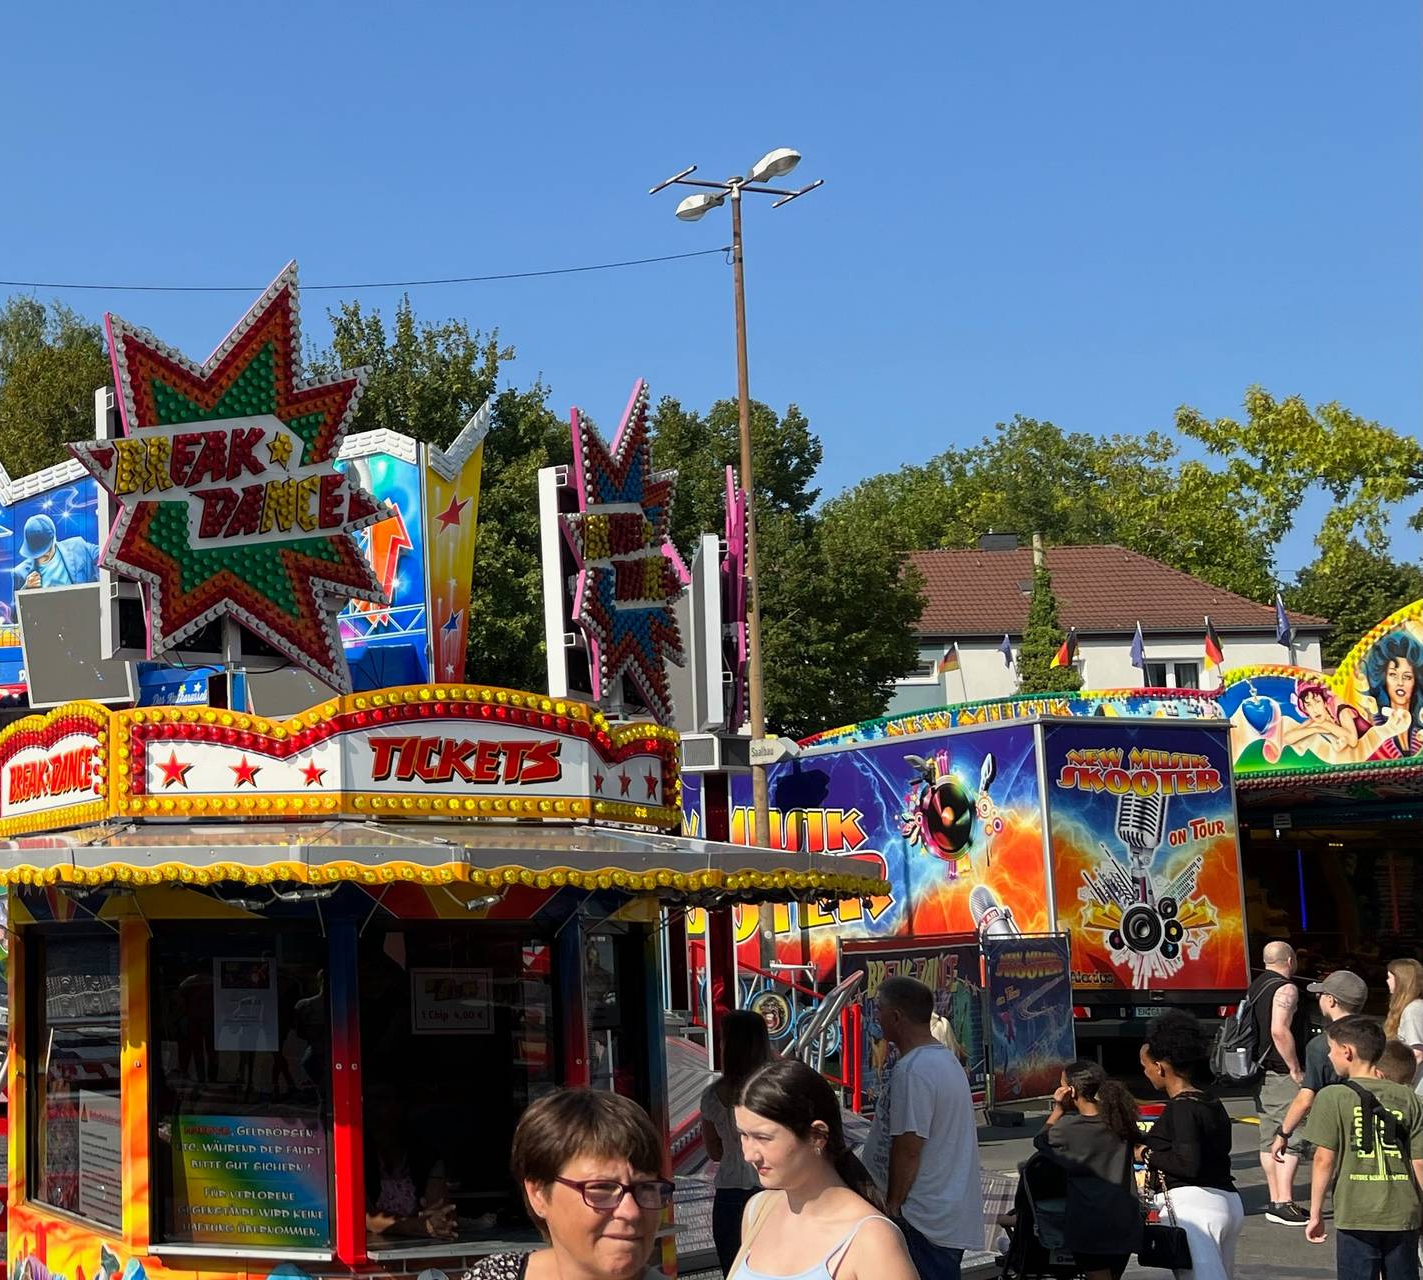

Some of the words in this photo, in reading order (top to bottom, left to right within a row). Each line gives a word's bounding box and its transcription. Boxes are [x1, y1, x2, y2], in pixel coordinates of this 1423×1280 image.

[111, 426, 267, 496] BREAK
[191, 473, 346, 539] DANCE
[9, 759, 49, 805] BREAK
[49, 745, 93, 797] DANCE
[367, 735, 563, 785] TICKETS
[1056, 766, 1224, 798] SKOOTER
[1065, 747, 1124, 769] NEW
[1128, 746, 1212, 770] MUSIK
[225, 1160, 249, 1170] GUT
